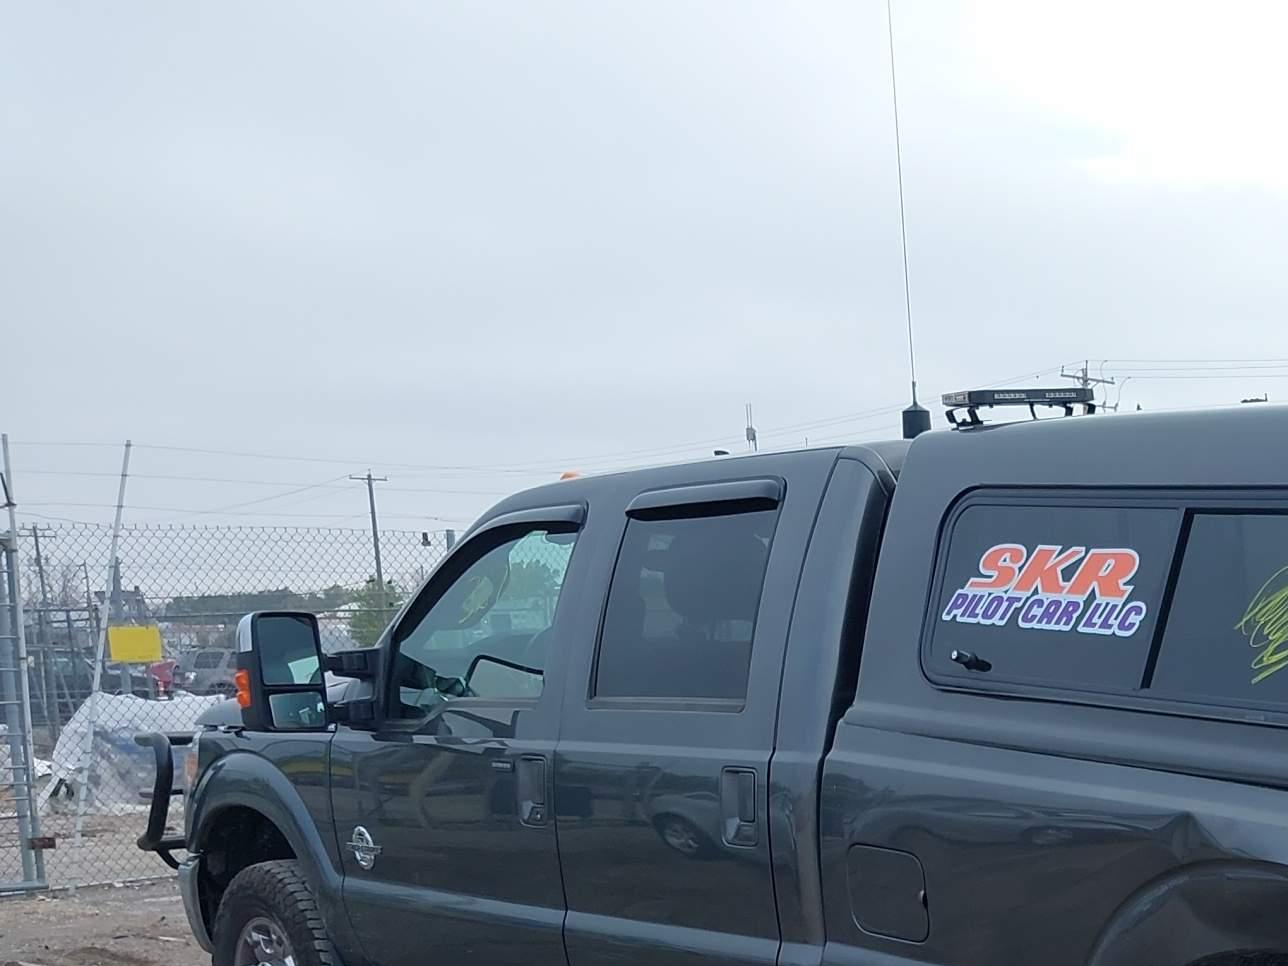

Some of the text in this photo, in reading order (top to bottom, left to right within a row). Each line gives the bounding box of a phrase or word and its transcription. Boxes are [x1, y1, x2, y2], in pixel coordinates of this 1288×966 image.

[966, 543, 1140, 600] SKR
[943, 589, 1147, 638] PILOT CAR LLC
